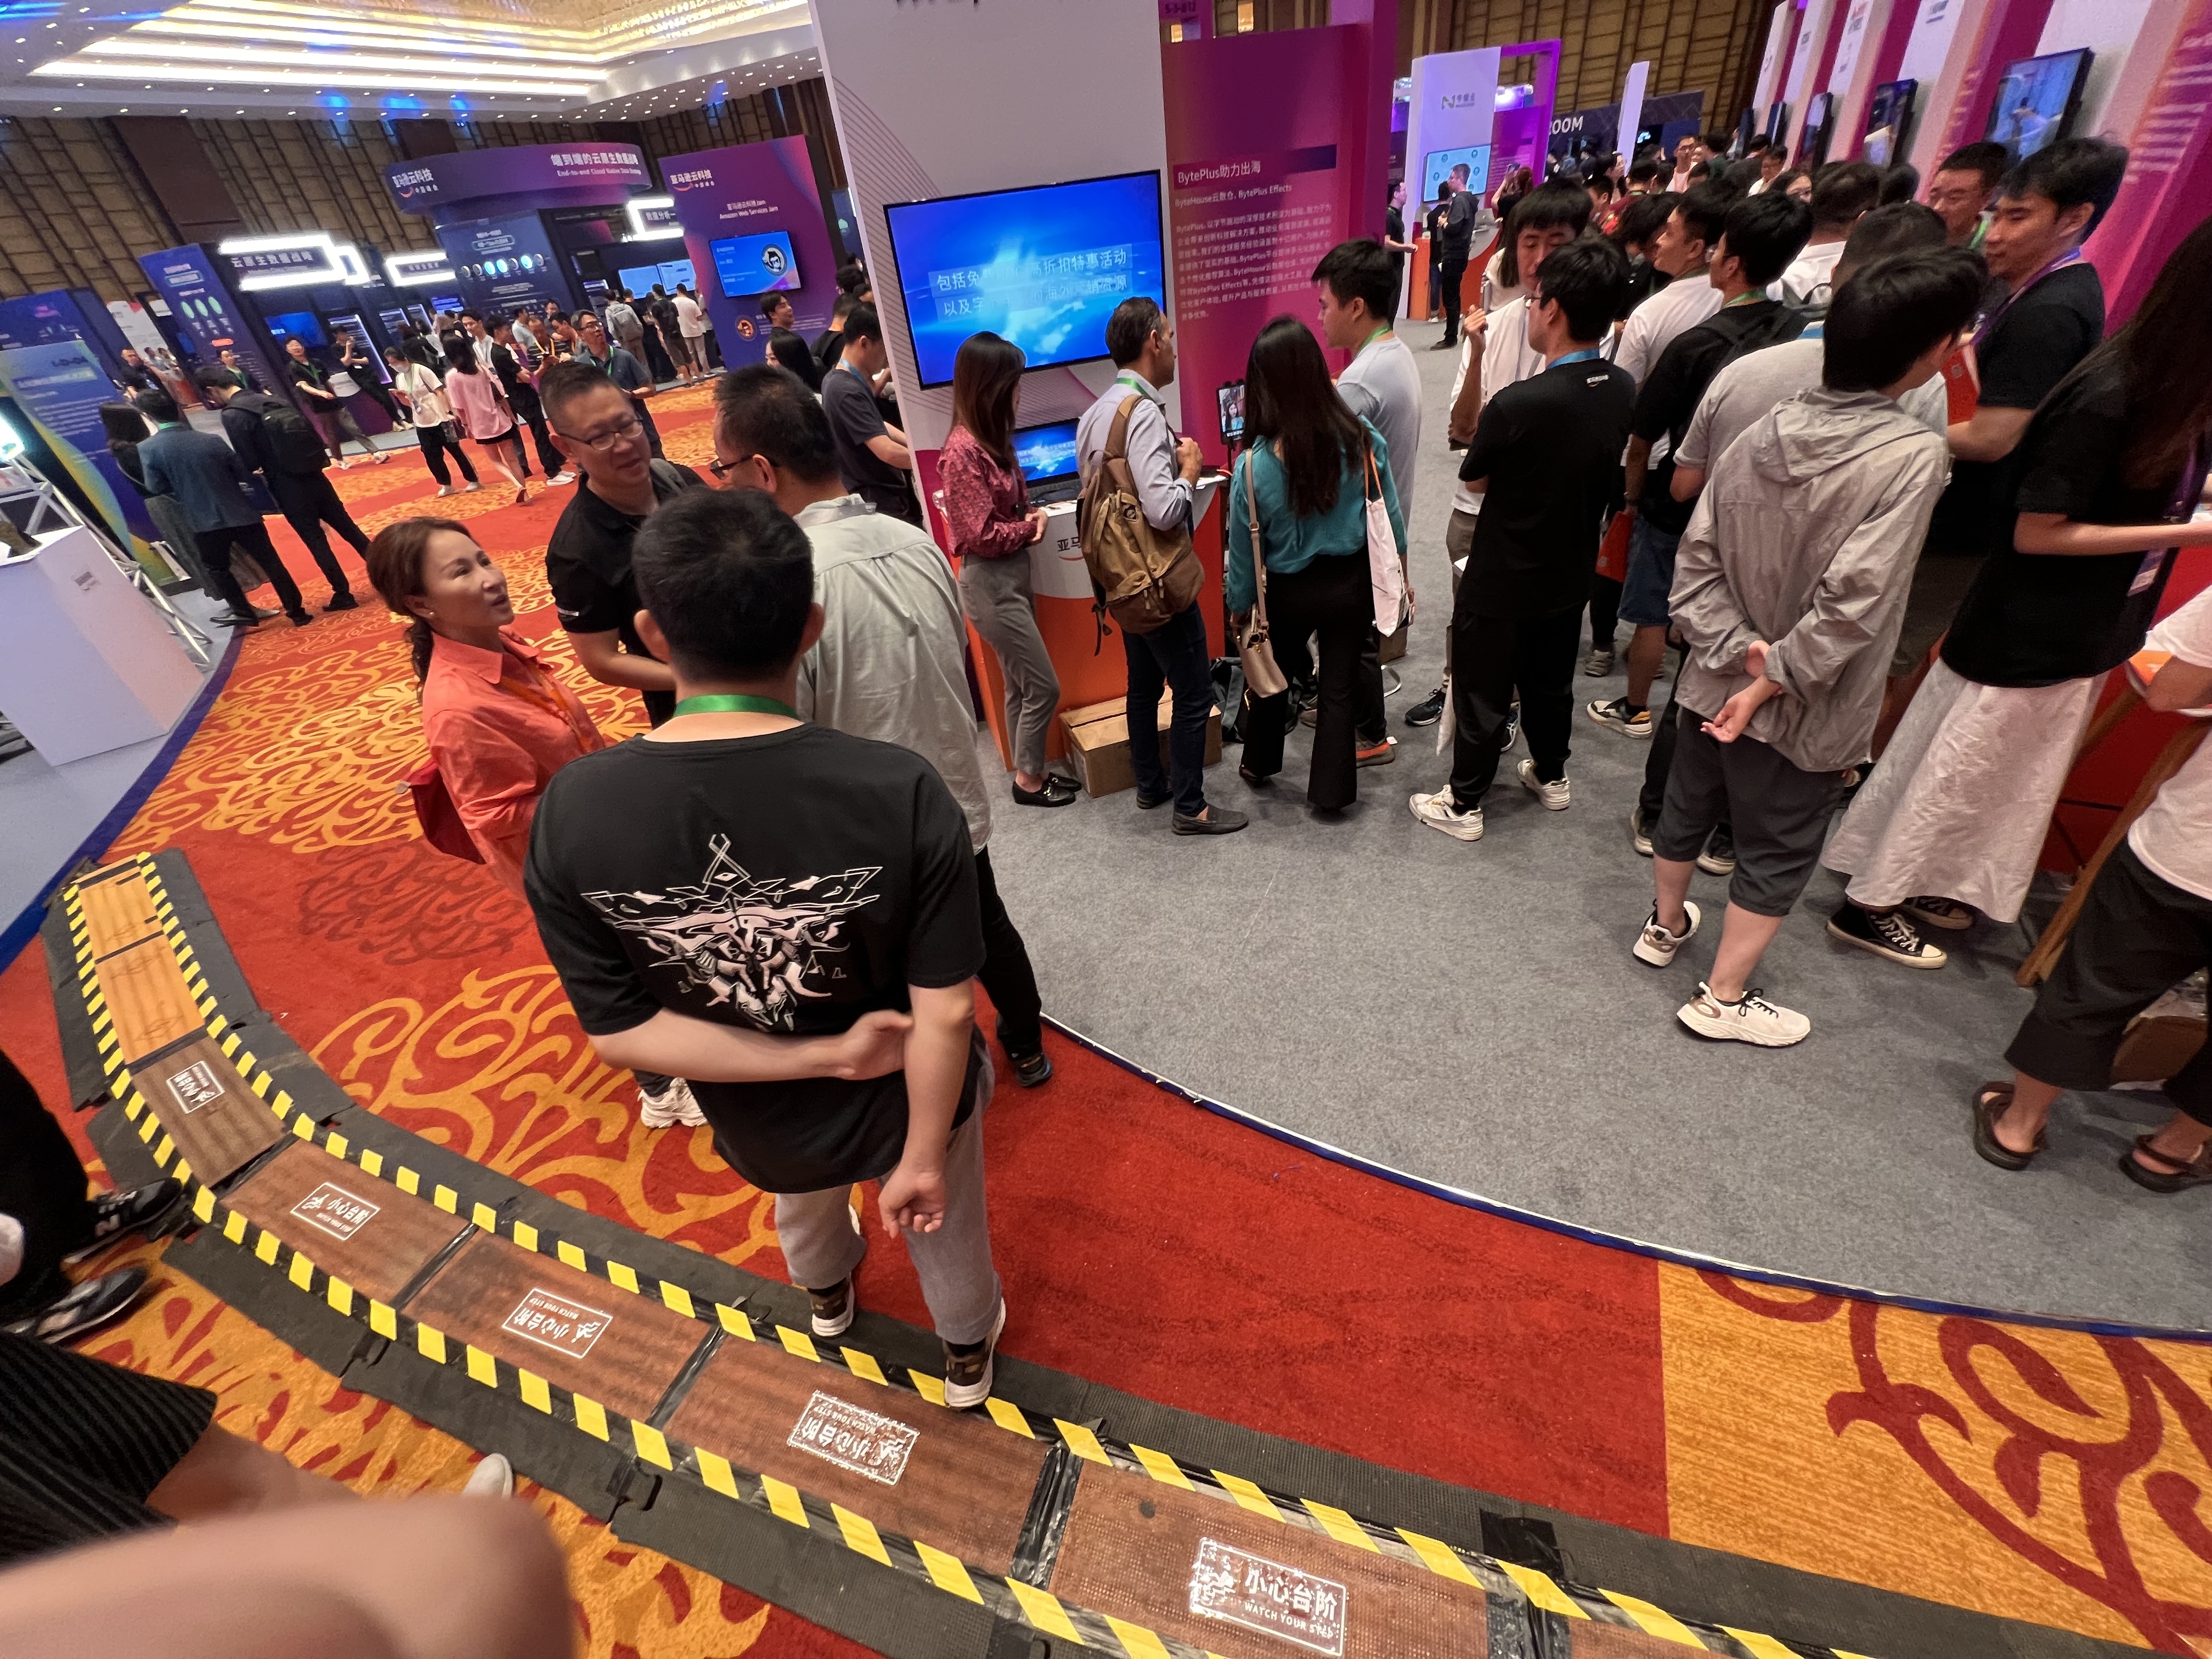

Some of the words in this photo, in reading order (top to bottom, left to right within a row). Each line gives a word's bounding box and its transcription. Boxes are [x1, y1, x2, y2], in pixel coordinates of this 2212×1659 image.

[1549, 115, 1583, 134] OOM
[1178, 160, 1261, 185] BytePlus助力出海
[1238, 187, 1267, 200] BytePlus
[1269, 184, 1292, 194] Effects
[328, 1197, 370, 1224] 小心台阶
[543, 1303, 559, 1312] YOUR
[558, 1308, 579, 1320] WATCH
[514, 1307, 570, 1340] 小心台阶
[814, 1405, 832, 1417] STEP
[832, 1411, 852, 1425] YOUR
[851, 1419, 877, 1435] WATCH
[802, 1417, 869, 1459] 小心台阶
[1245, 1568, 1338, 1621] 小心台阶
[1244, 1601, 1277, 1620] WATCH
[1280, 1614, 1306, 1630] YOUR
[1310, 1623, 1334, 1639] STEP
